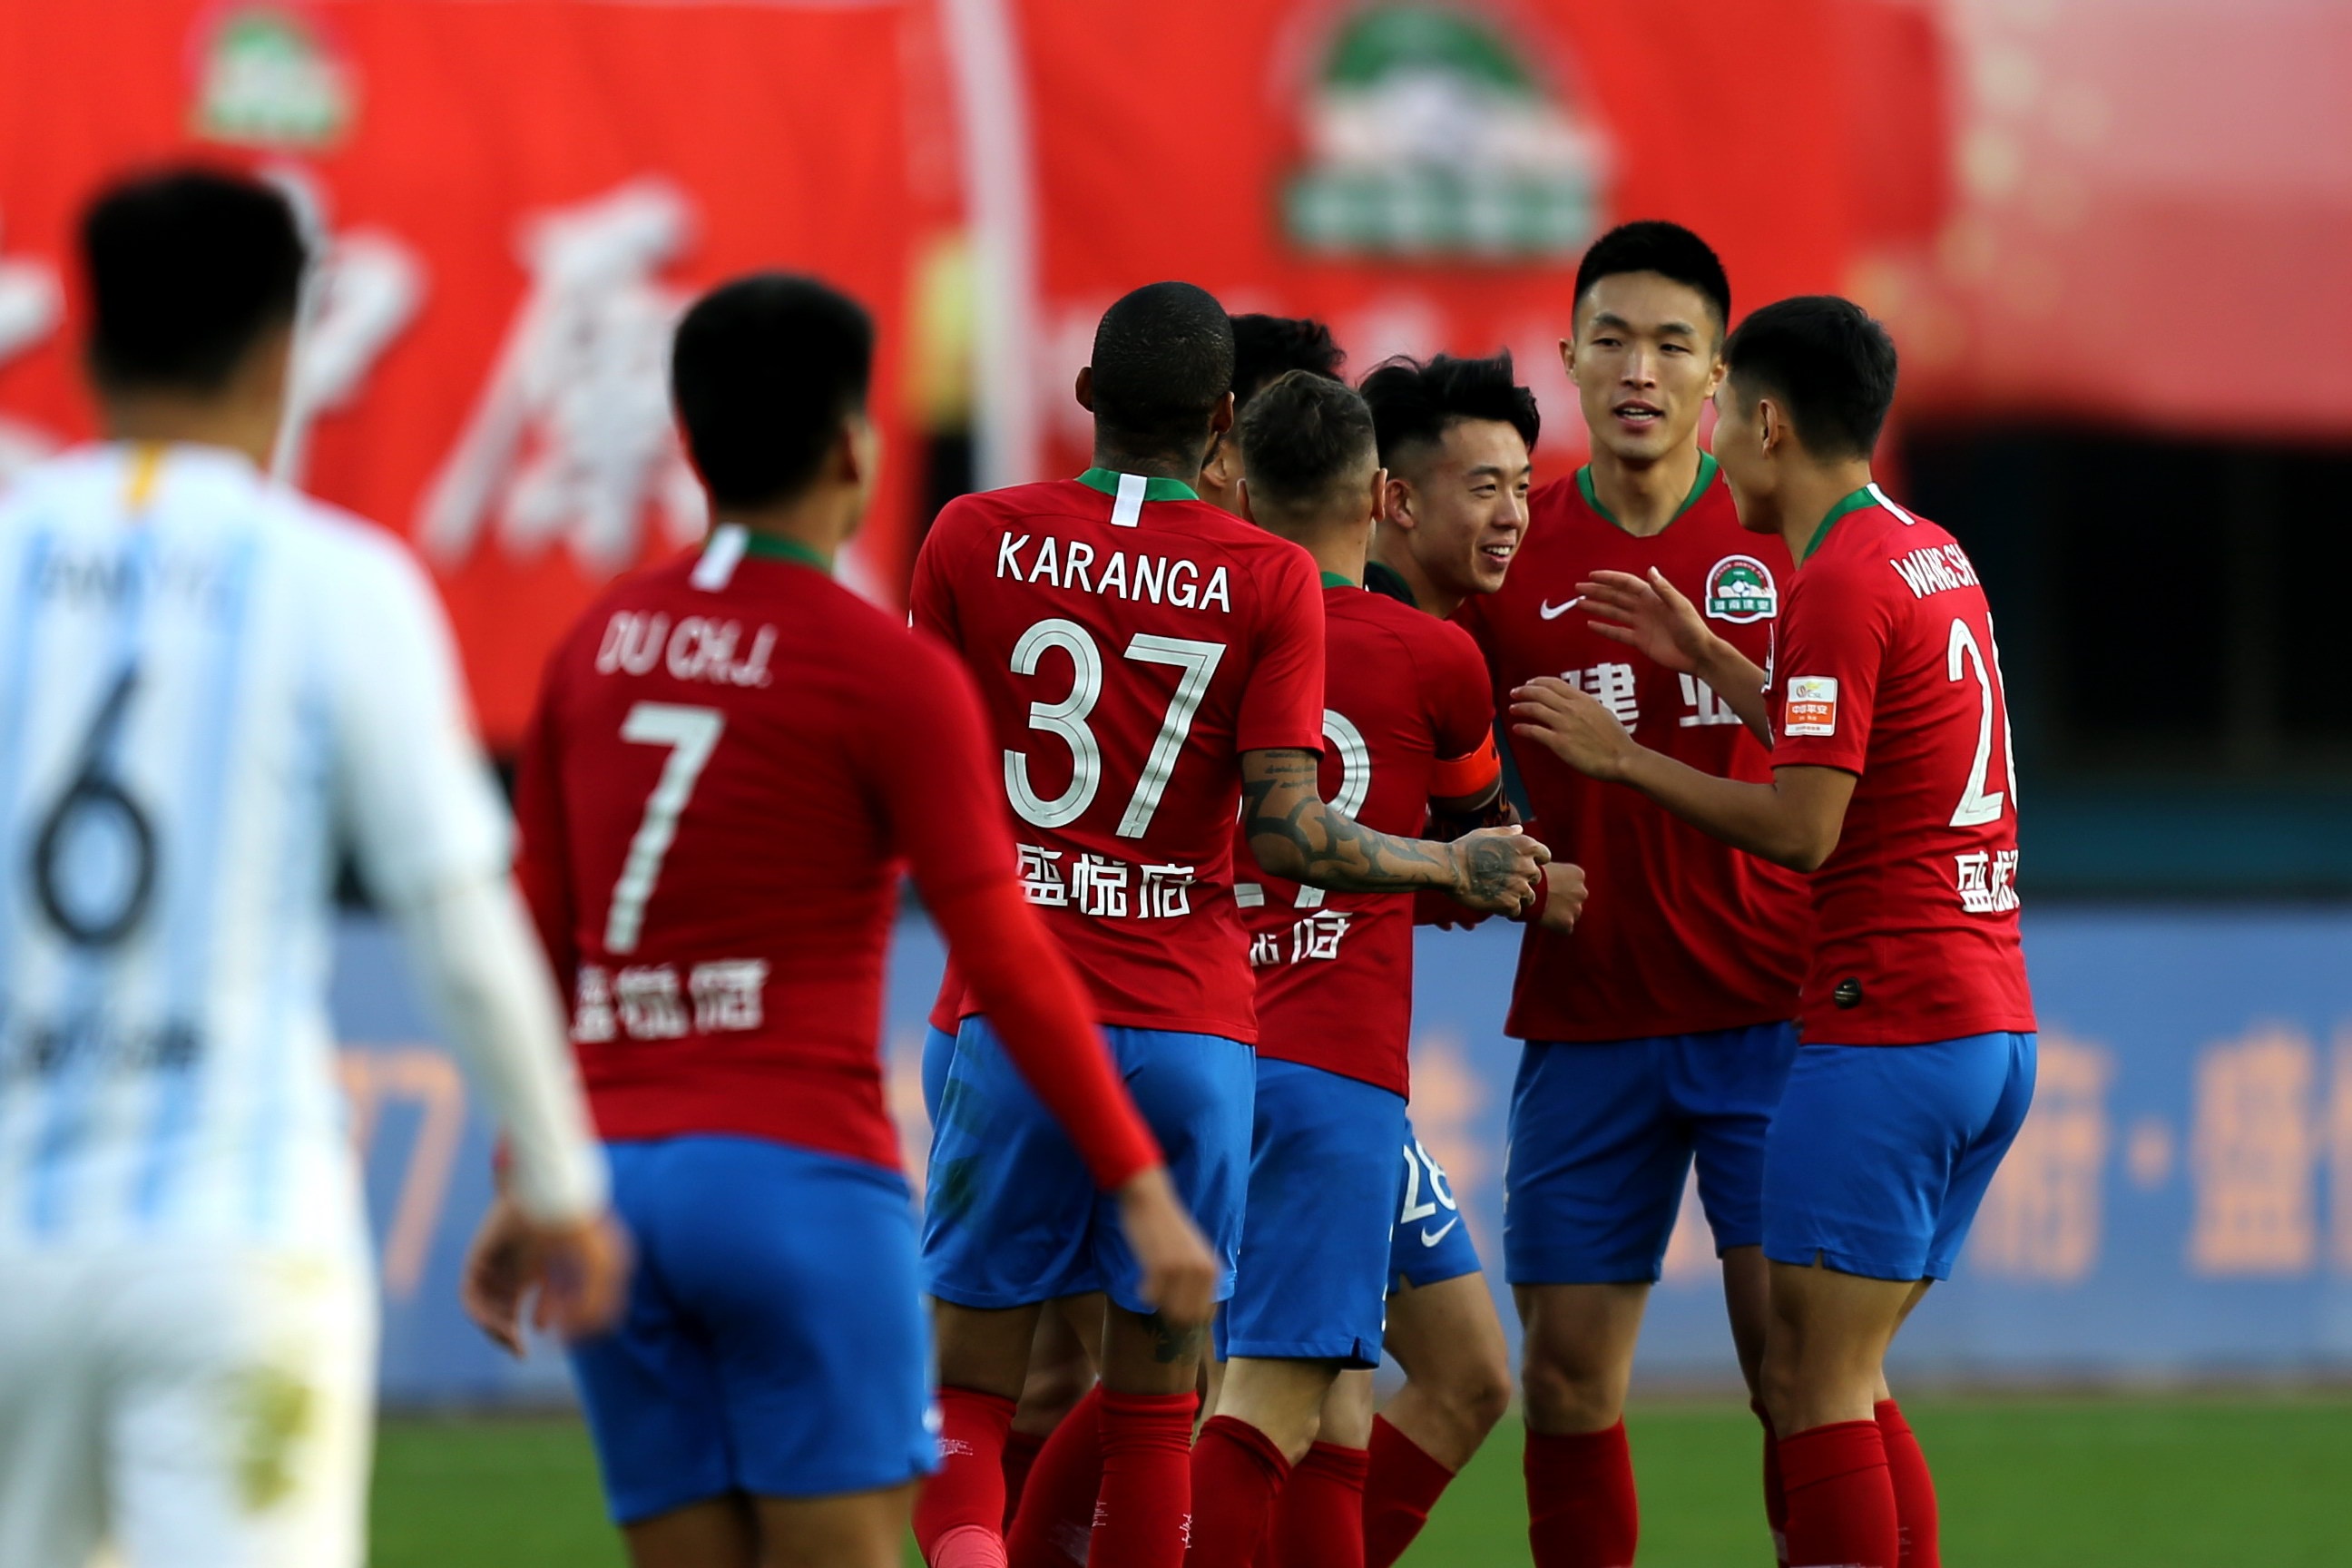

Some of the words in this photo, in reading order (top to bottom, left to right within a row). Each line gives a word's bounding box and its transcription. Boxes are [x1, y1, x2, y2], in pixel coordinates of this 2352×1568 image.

[595, 610, 670, 675] DU
[996, 532, 1231, 612] KARANGA
[30, 658, 160, 953] 6
[603, 700, 725, 955] 7
[1004, 618, 1227, 839] 37
